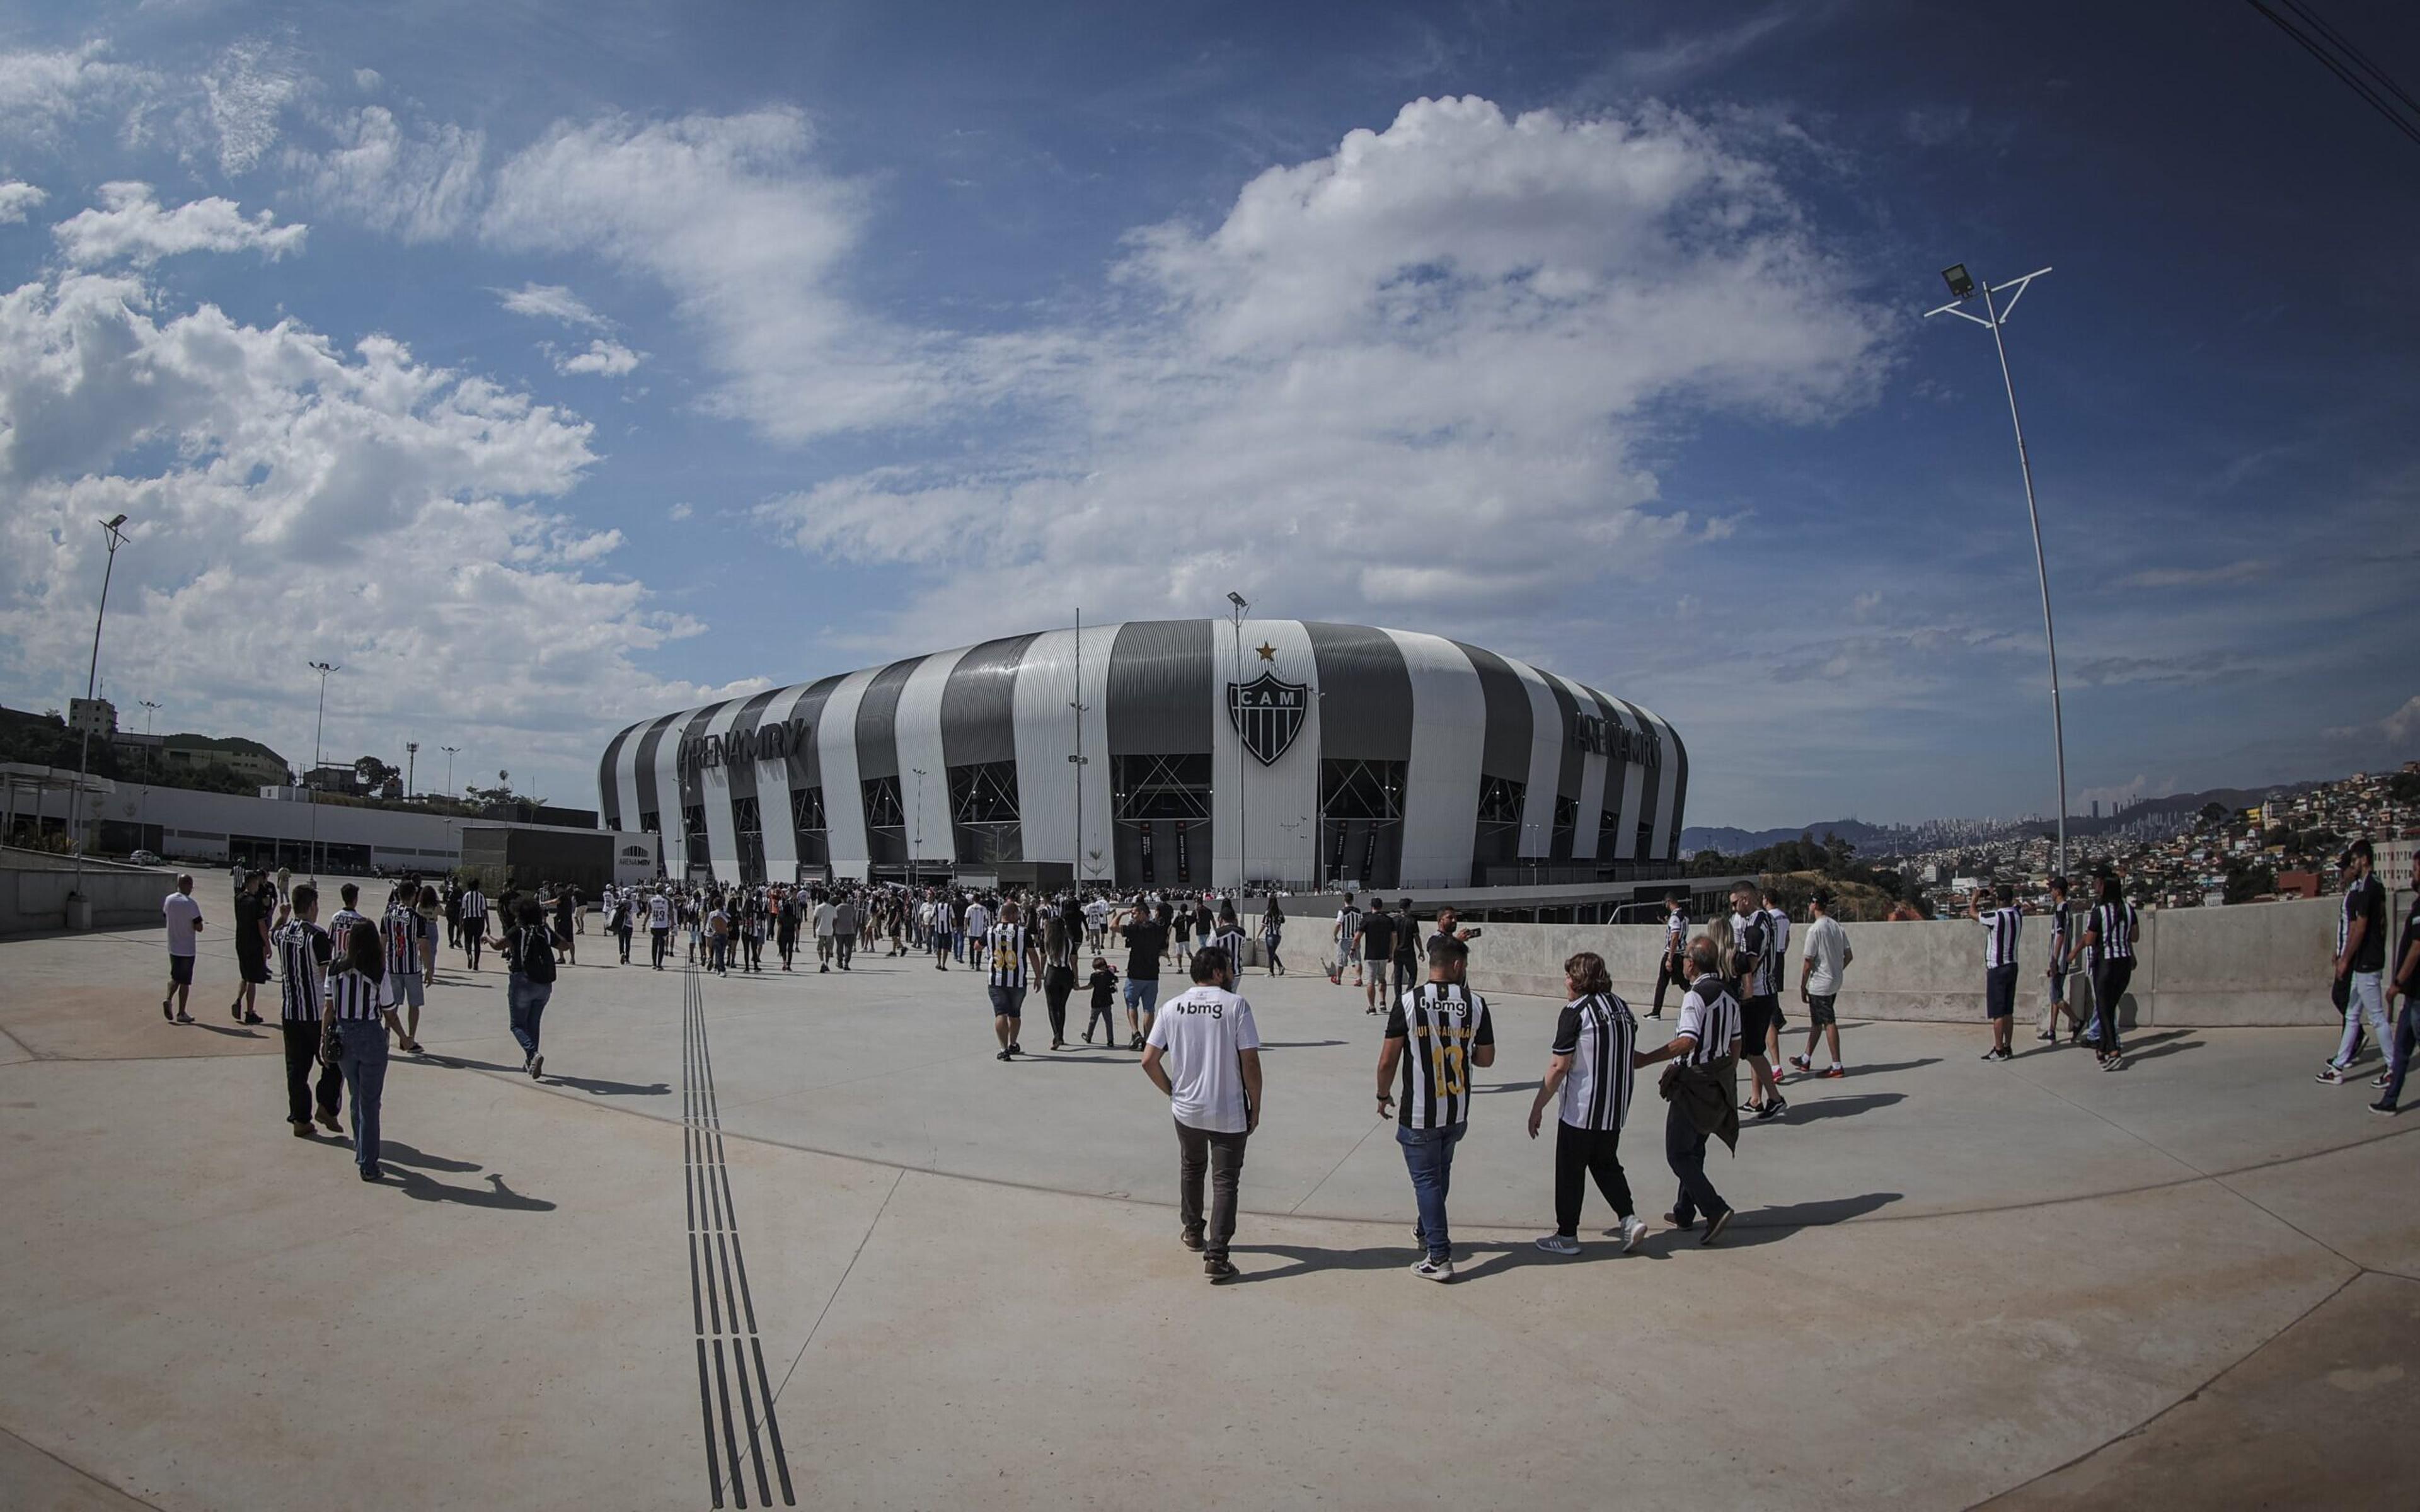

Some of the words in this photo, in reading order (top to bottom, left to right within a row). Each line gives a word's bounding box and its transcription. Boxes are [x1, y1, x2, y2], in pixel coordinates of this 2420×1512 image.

[1241, 691, 1294, 705] CAM
[998, 929, 1015, 938] bmg
[1187, 1002, 1223, 1019] bmg
[1432, 997, 1466, 1017] bmg
[1432, 1045, 1466, 1098] 13
